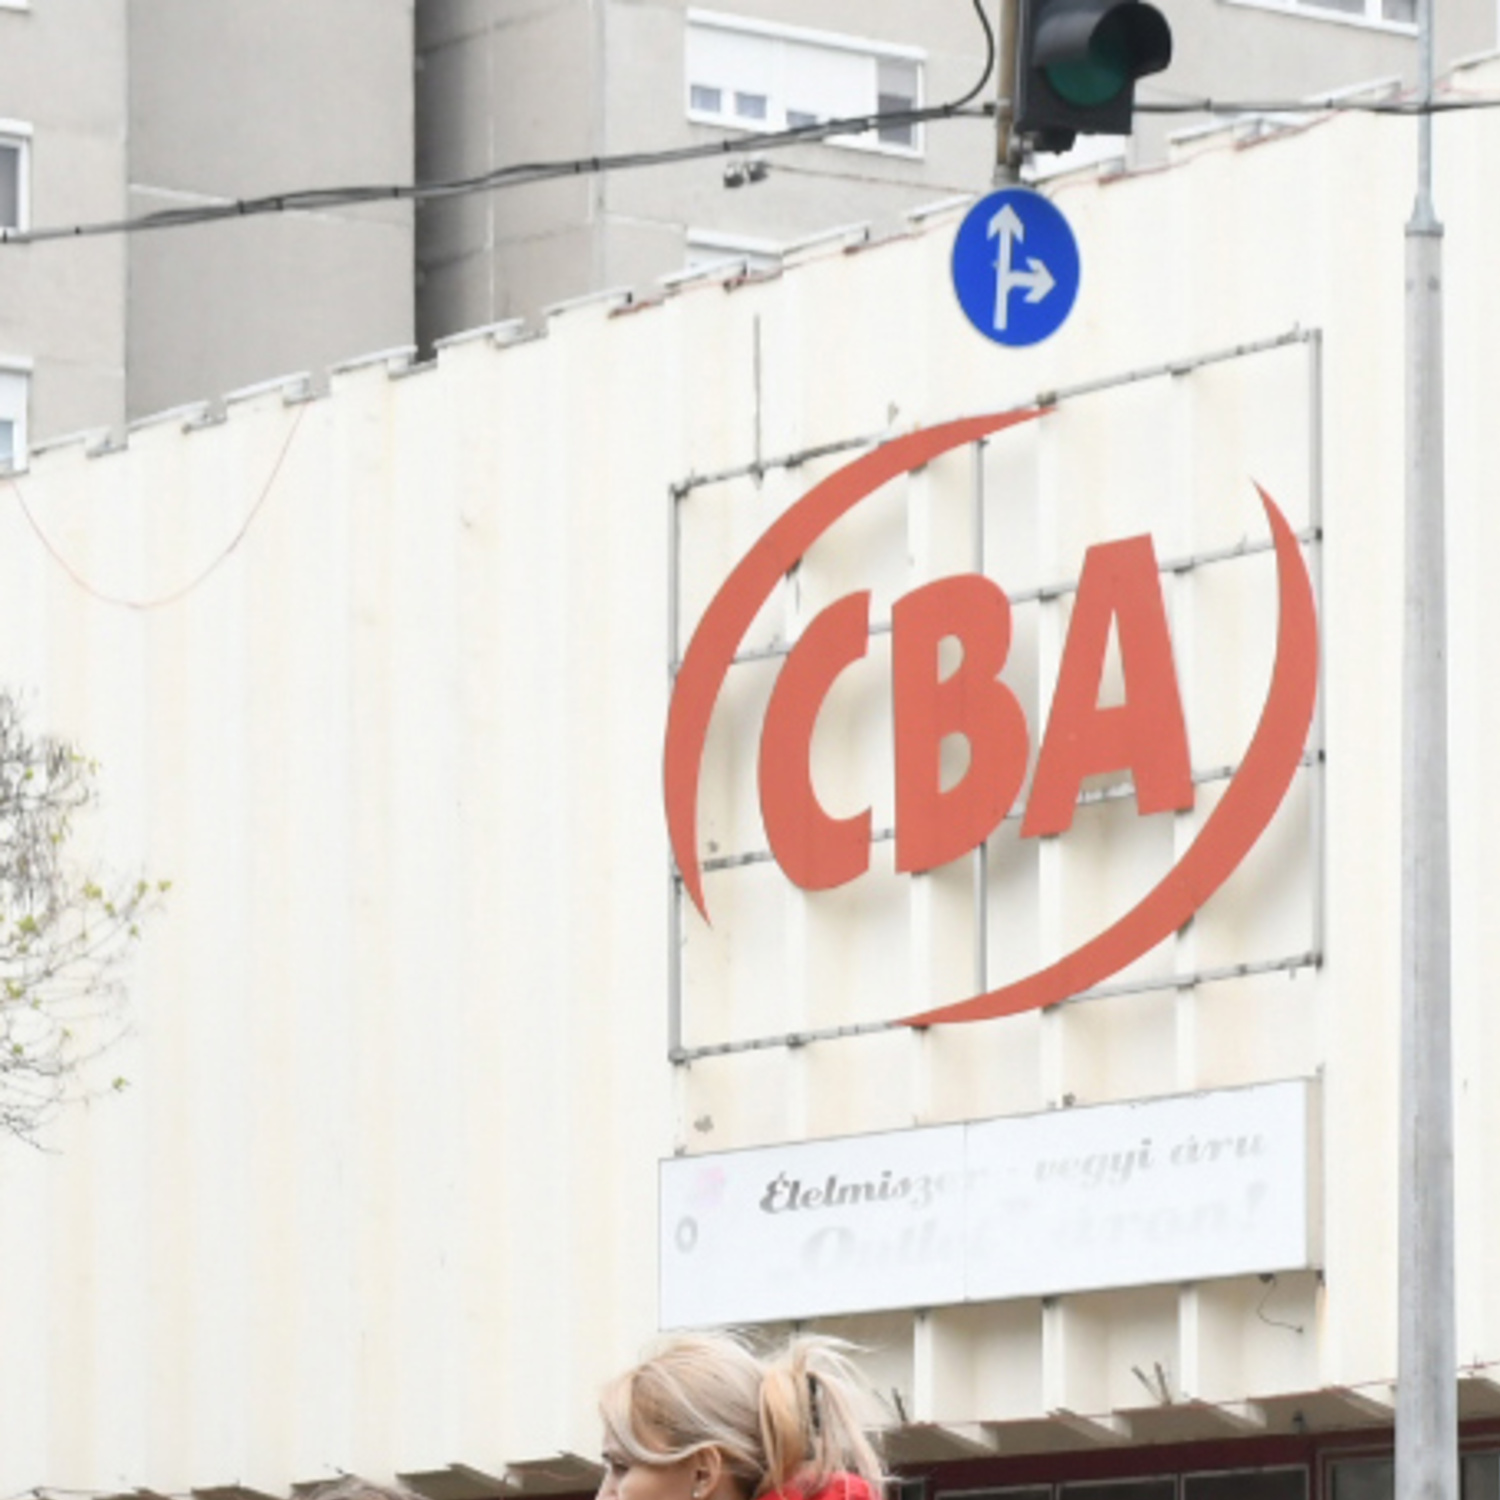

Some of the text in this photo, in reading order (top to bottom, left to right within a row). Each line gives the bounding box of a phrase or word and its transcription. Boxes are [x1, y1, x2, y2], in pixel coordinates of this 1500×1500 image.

[758, 533, 1195, 891] CBA
[1035, 1137, 1155, 1189] vegyi
[1169, 1132, 1267, 1166] áru
